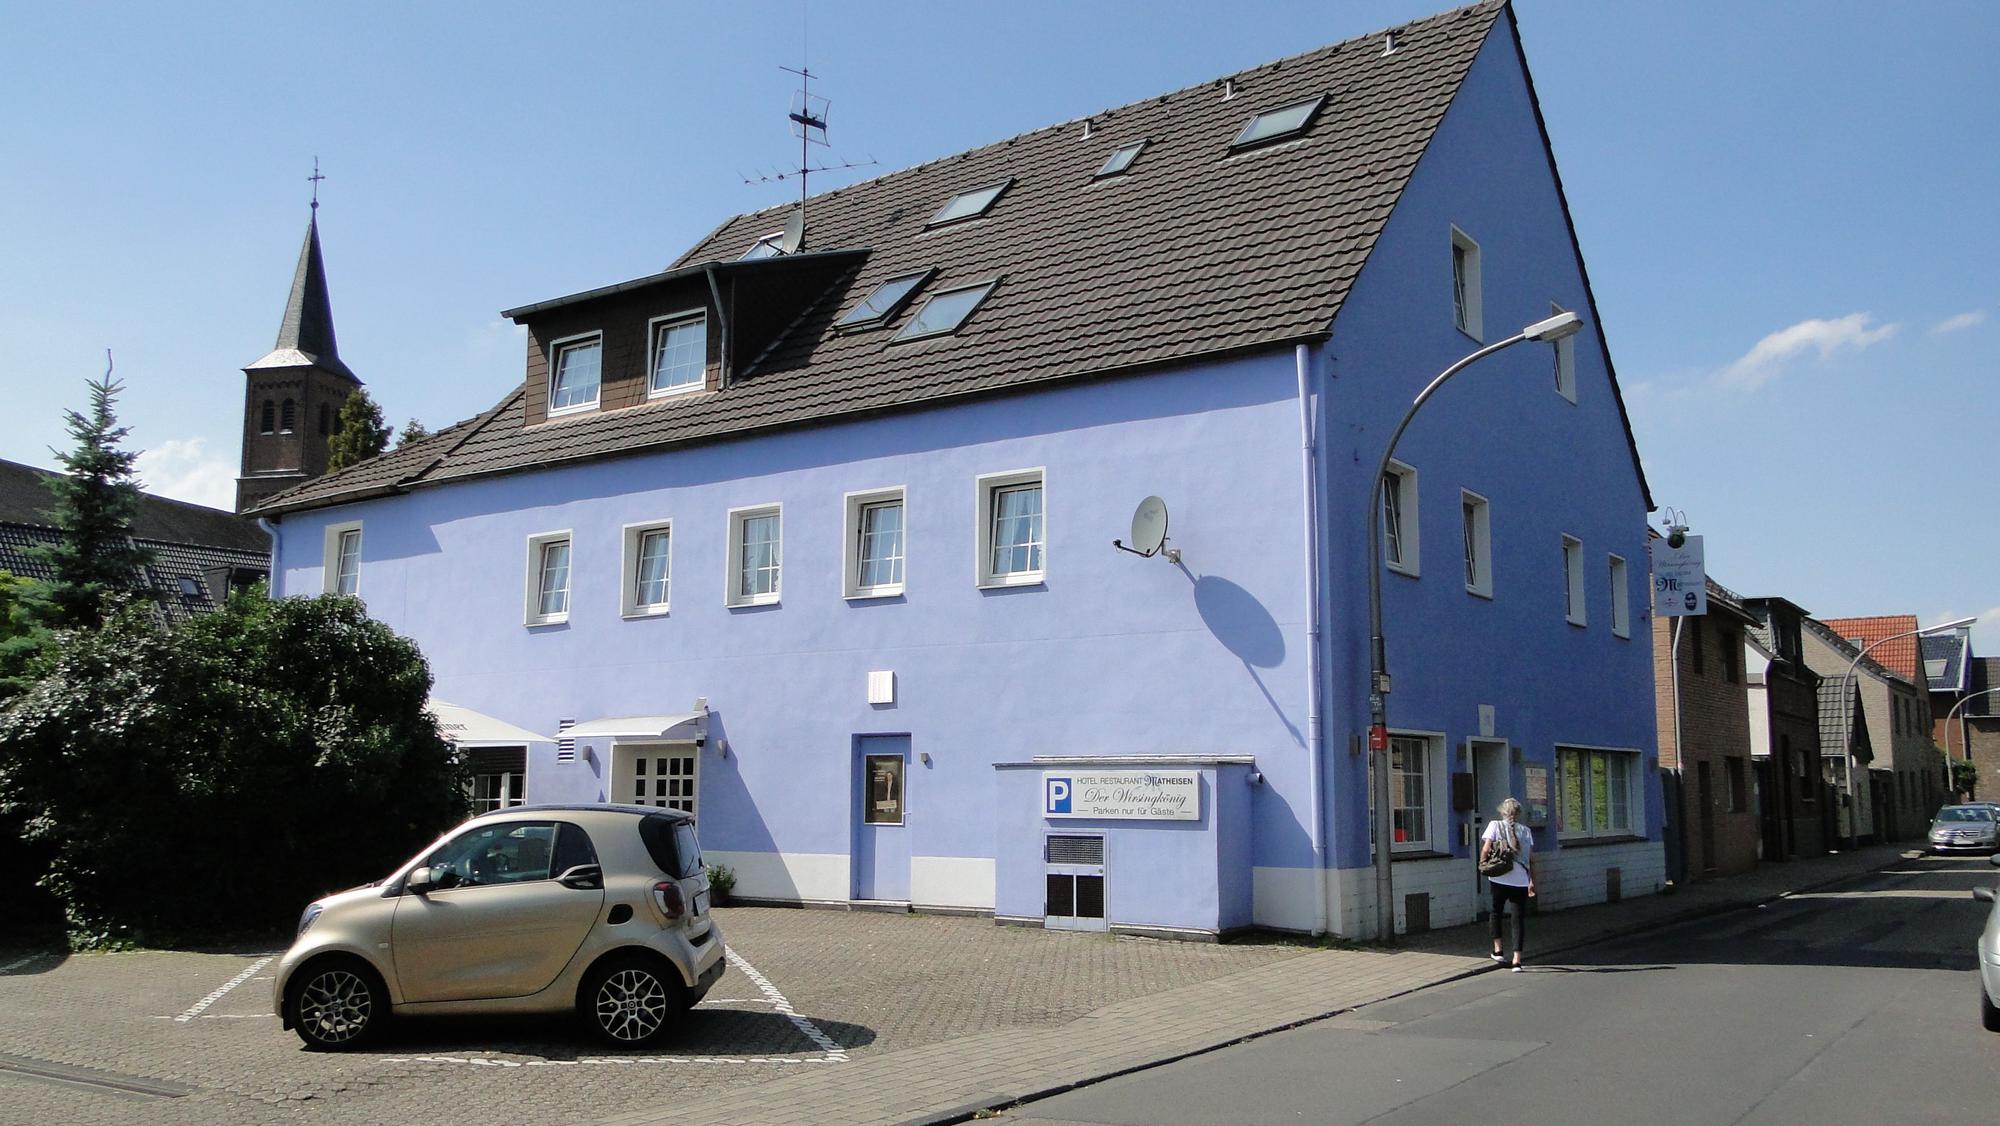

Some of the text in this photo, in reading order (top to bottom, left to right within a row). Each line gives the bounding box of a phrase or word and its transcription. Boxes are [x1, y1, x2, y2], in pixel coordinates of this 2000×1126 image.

[1077, 775, 1193, 786] HOTEL RESTAURANT MATHEISEN
[1049, 781, 1069, 811] P
[1083, 787, 1186, 809] Der Wirsingkönig
[1093, 807, 1119, 815] Parken
[1137, 807, 1147, 815] für
[1150, 807, 1175, 816] Gäste
